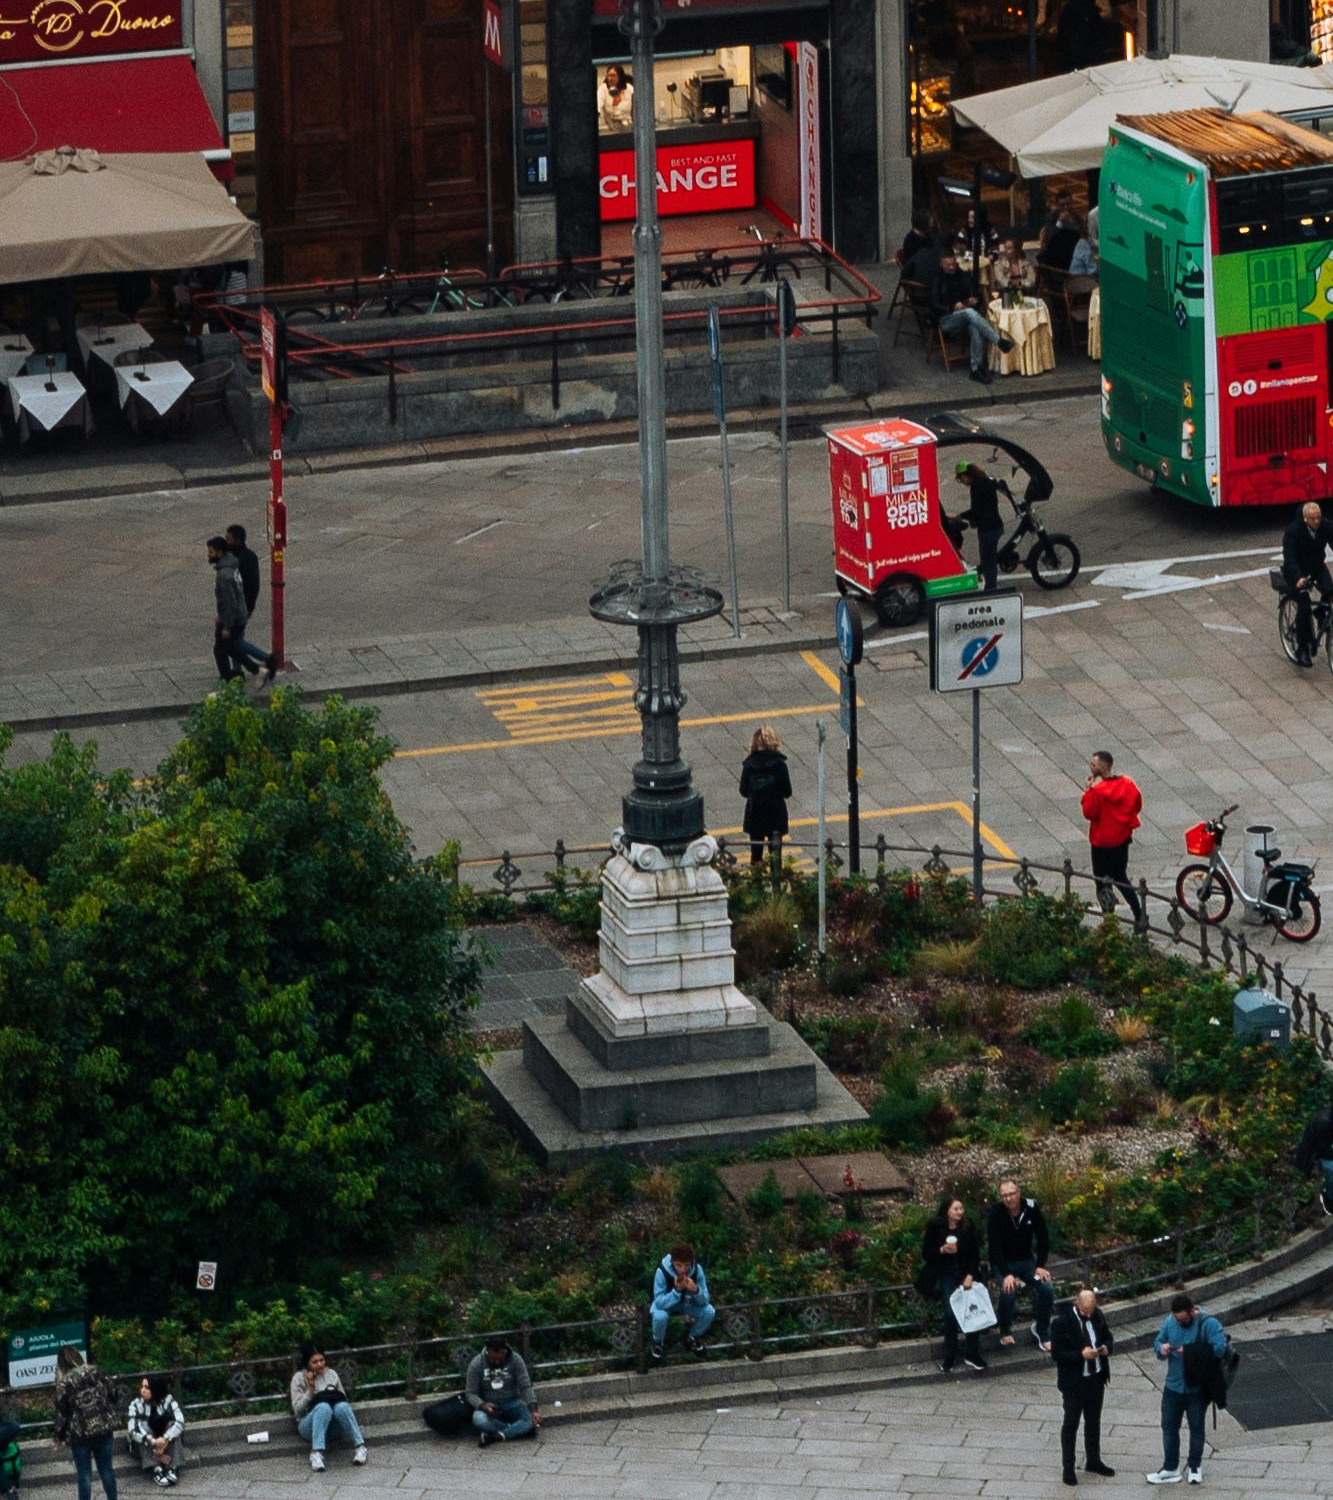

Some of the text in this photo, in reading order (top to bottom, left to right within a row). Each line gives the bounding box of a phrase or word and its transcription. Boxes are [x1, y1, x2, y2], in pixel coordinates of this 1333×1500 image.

[484, 9, 501, 56] M
[671, 153, 737, 167] BEST AND FAST
[885, 488, 928, 507] MILAN
[886, 501, 928, 519] OPEN
[888, 513, 929, 530] TOUR
[967, 605, 993, 615] area
[954, 616, 1006, 633] pedonale
[15, 1367, 38, 1379] OASI
